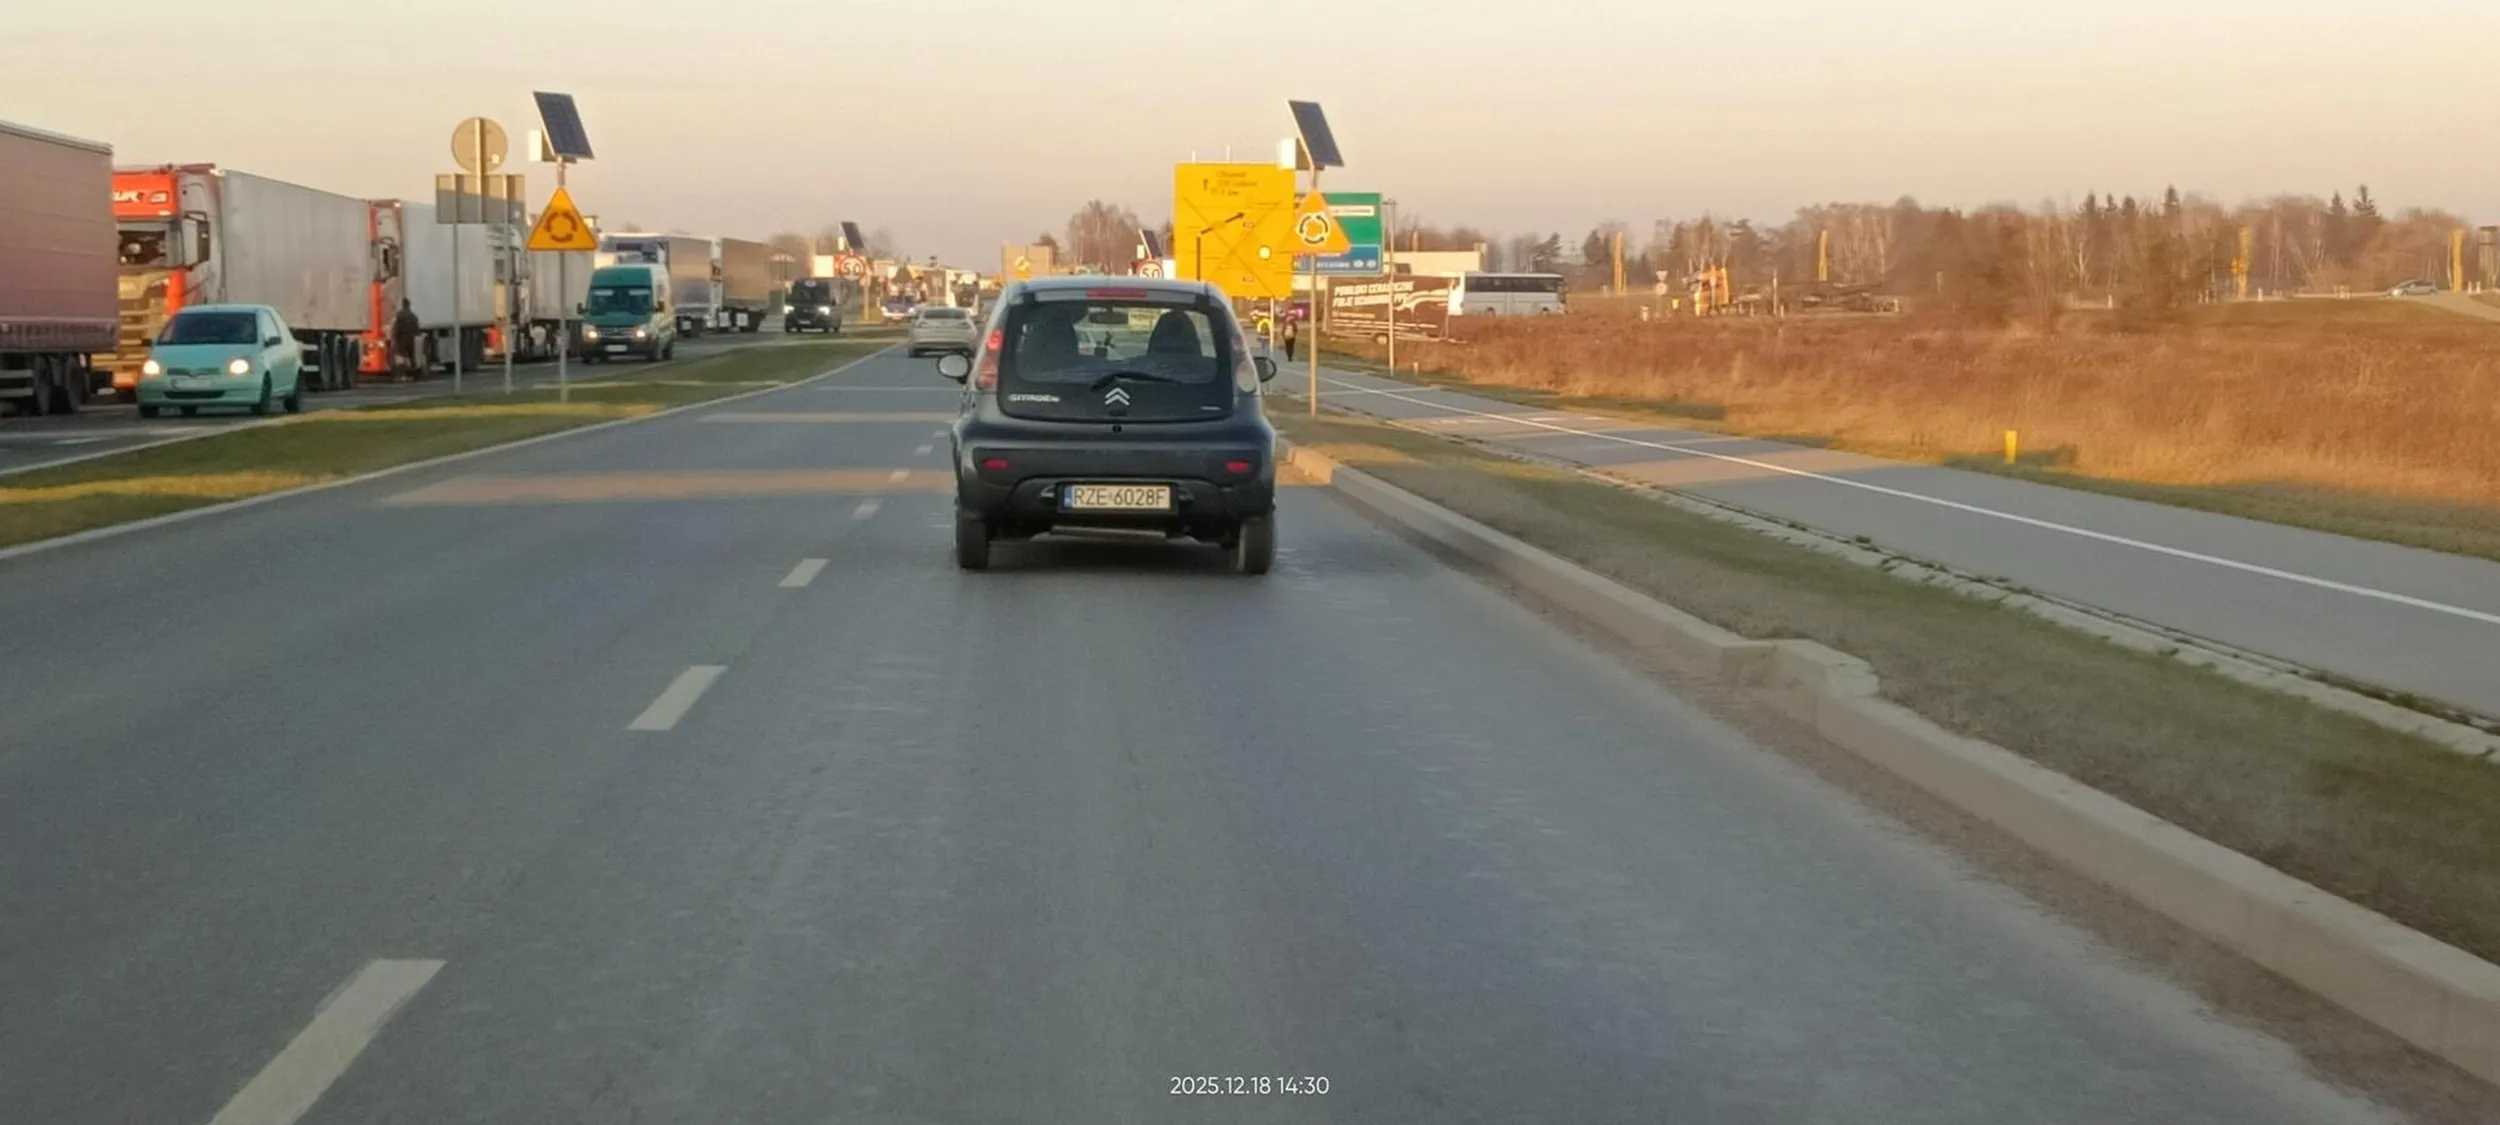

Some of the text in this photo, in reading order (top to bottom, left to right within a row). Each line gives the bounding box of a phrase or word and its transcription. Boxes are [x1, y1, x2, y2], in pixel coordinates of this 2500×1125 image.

[843, 262, 861, 275] 50
[1074, 487, 1167, 506] RZE 6028F
